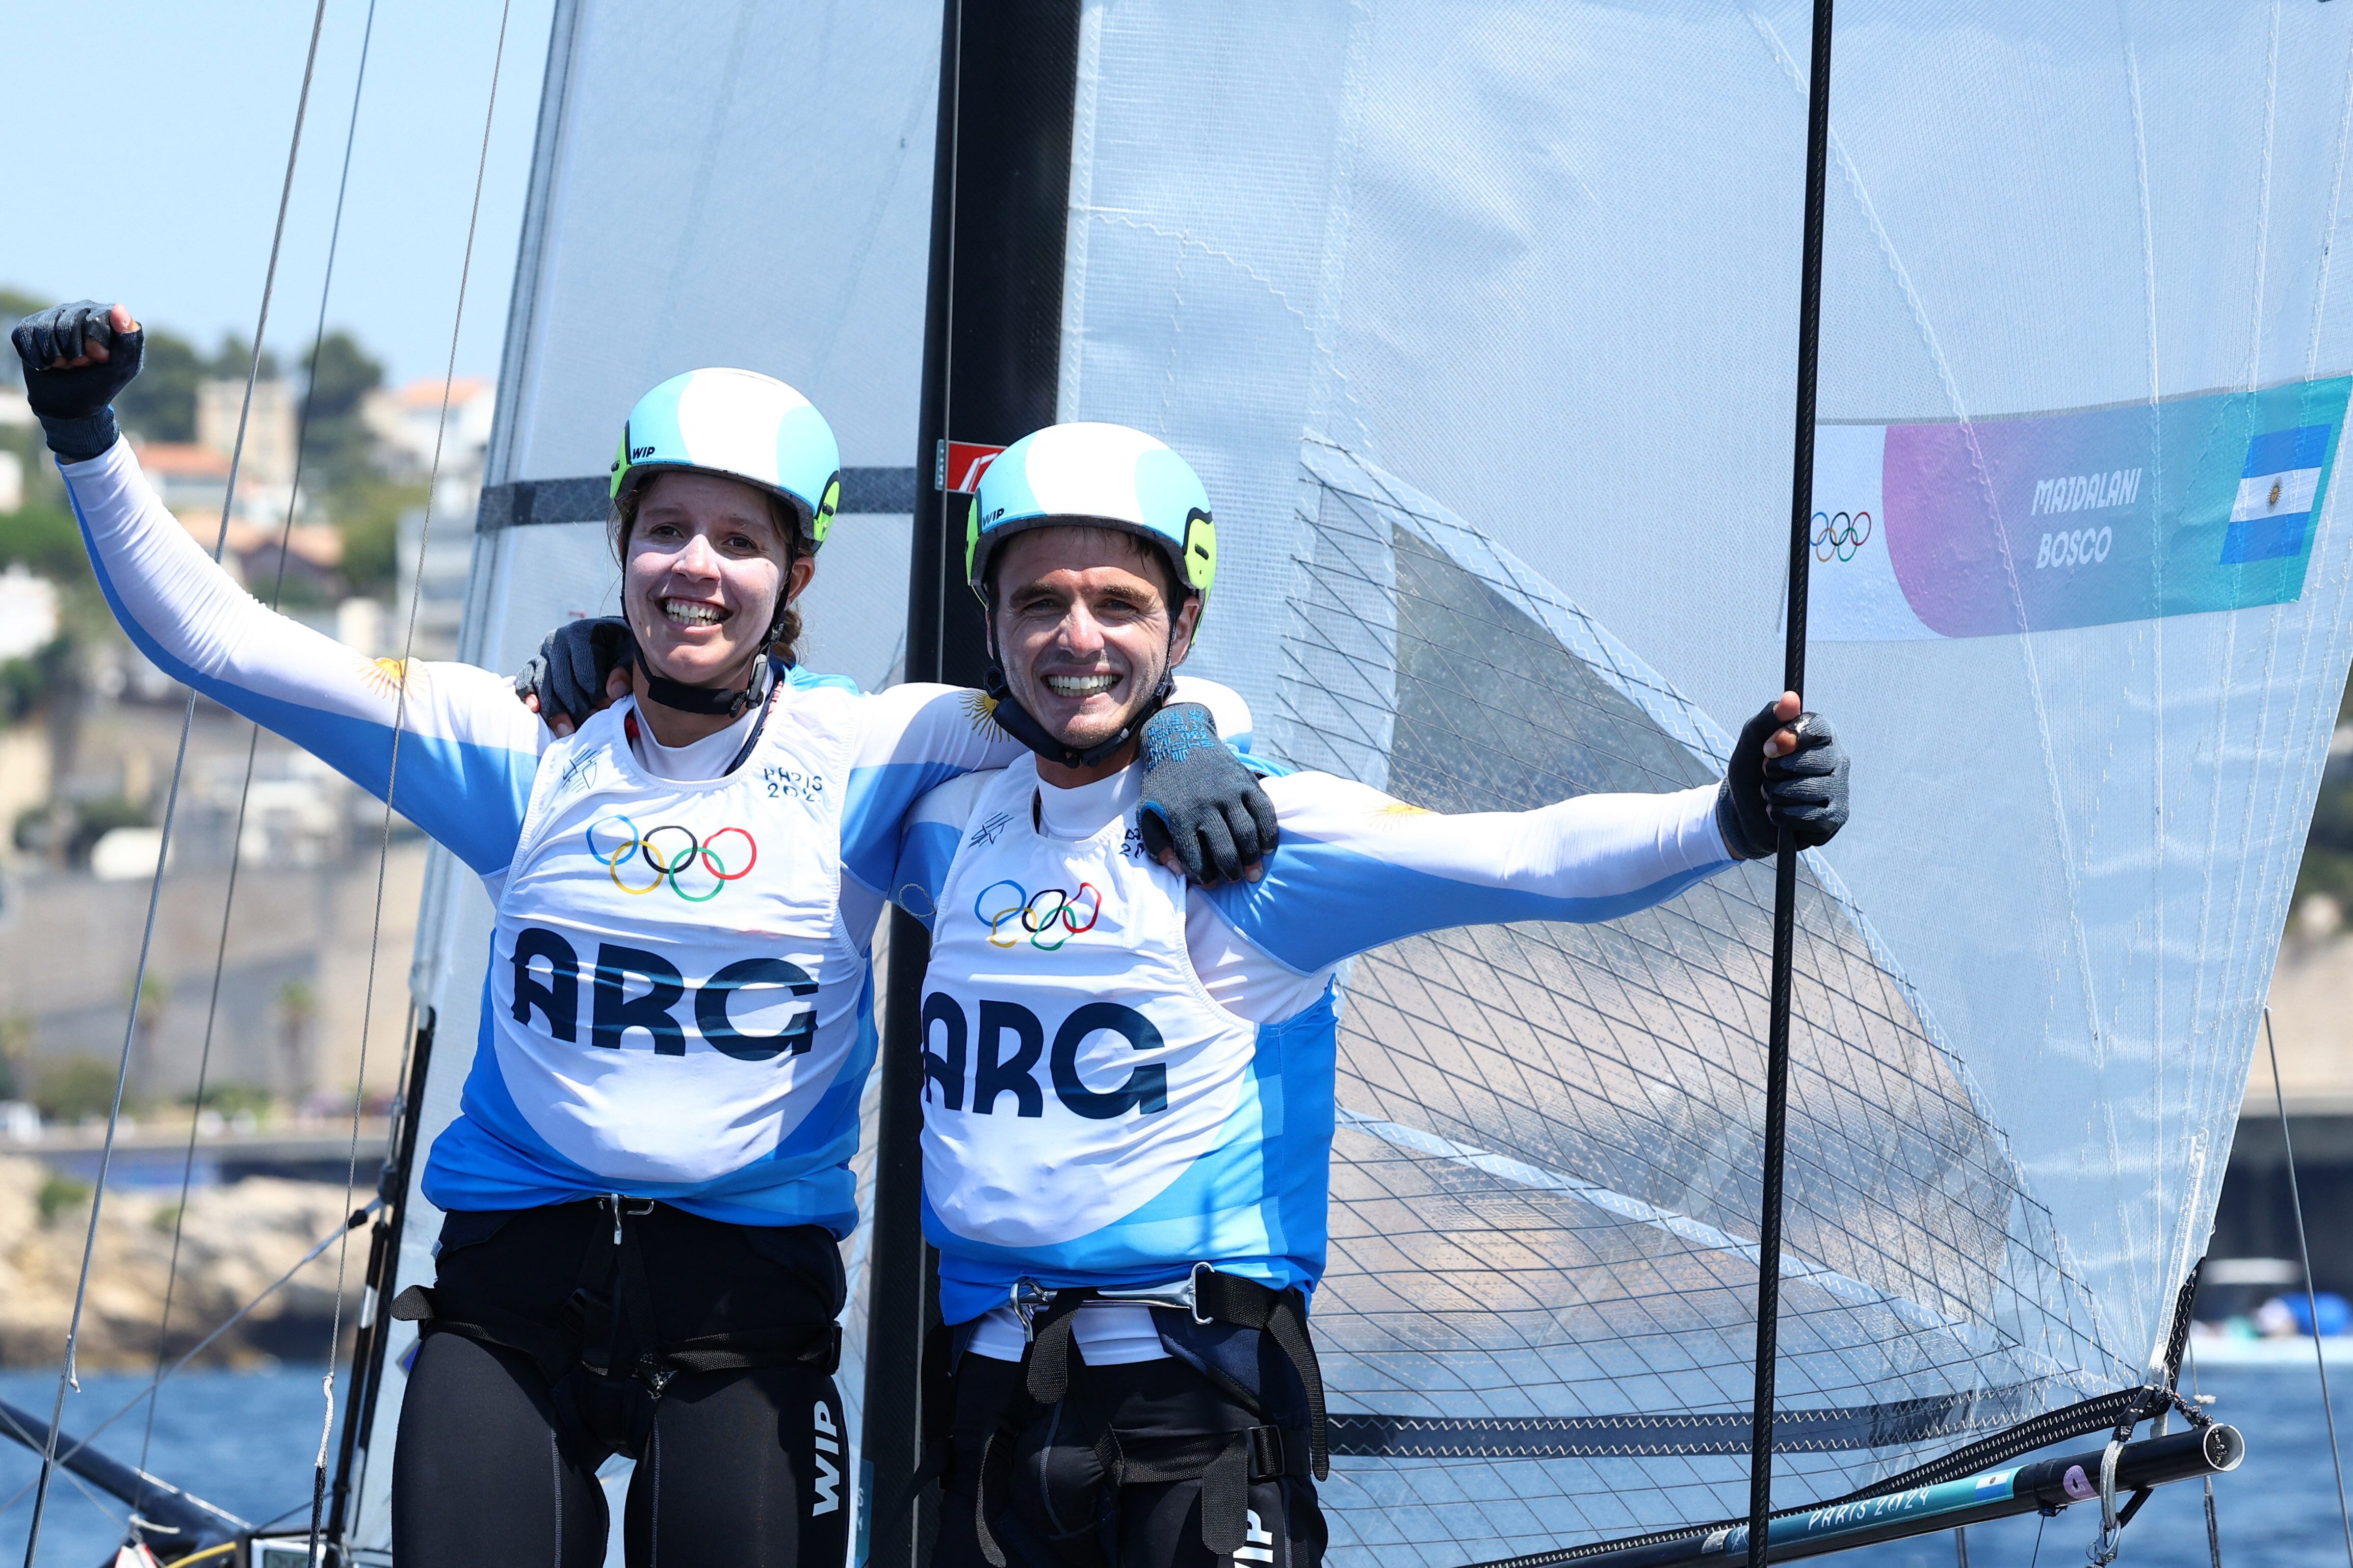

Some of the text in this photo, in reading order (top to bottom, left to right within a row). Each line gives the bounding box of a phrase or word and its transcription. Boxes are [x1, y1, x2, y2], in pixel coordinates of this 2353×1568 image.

[633, 446, 655, 459] WIP
[2030, 467, 2142, 516] MAJDALANI
[983, 508, 1004, 527] WIP
[2036, 525, 2112, 570] BOSCO
[510, 927, 819, 1061] ARG
[922, 992, 1168, 1120] ARG
[813, 1400, 840, 1517] WIP
[1808, 1487, 1931, 1530] PARIS 2024
[1233, 1509, 1273, 1568] IP
